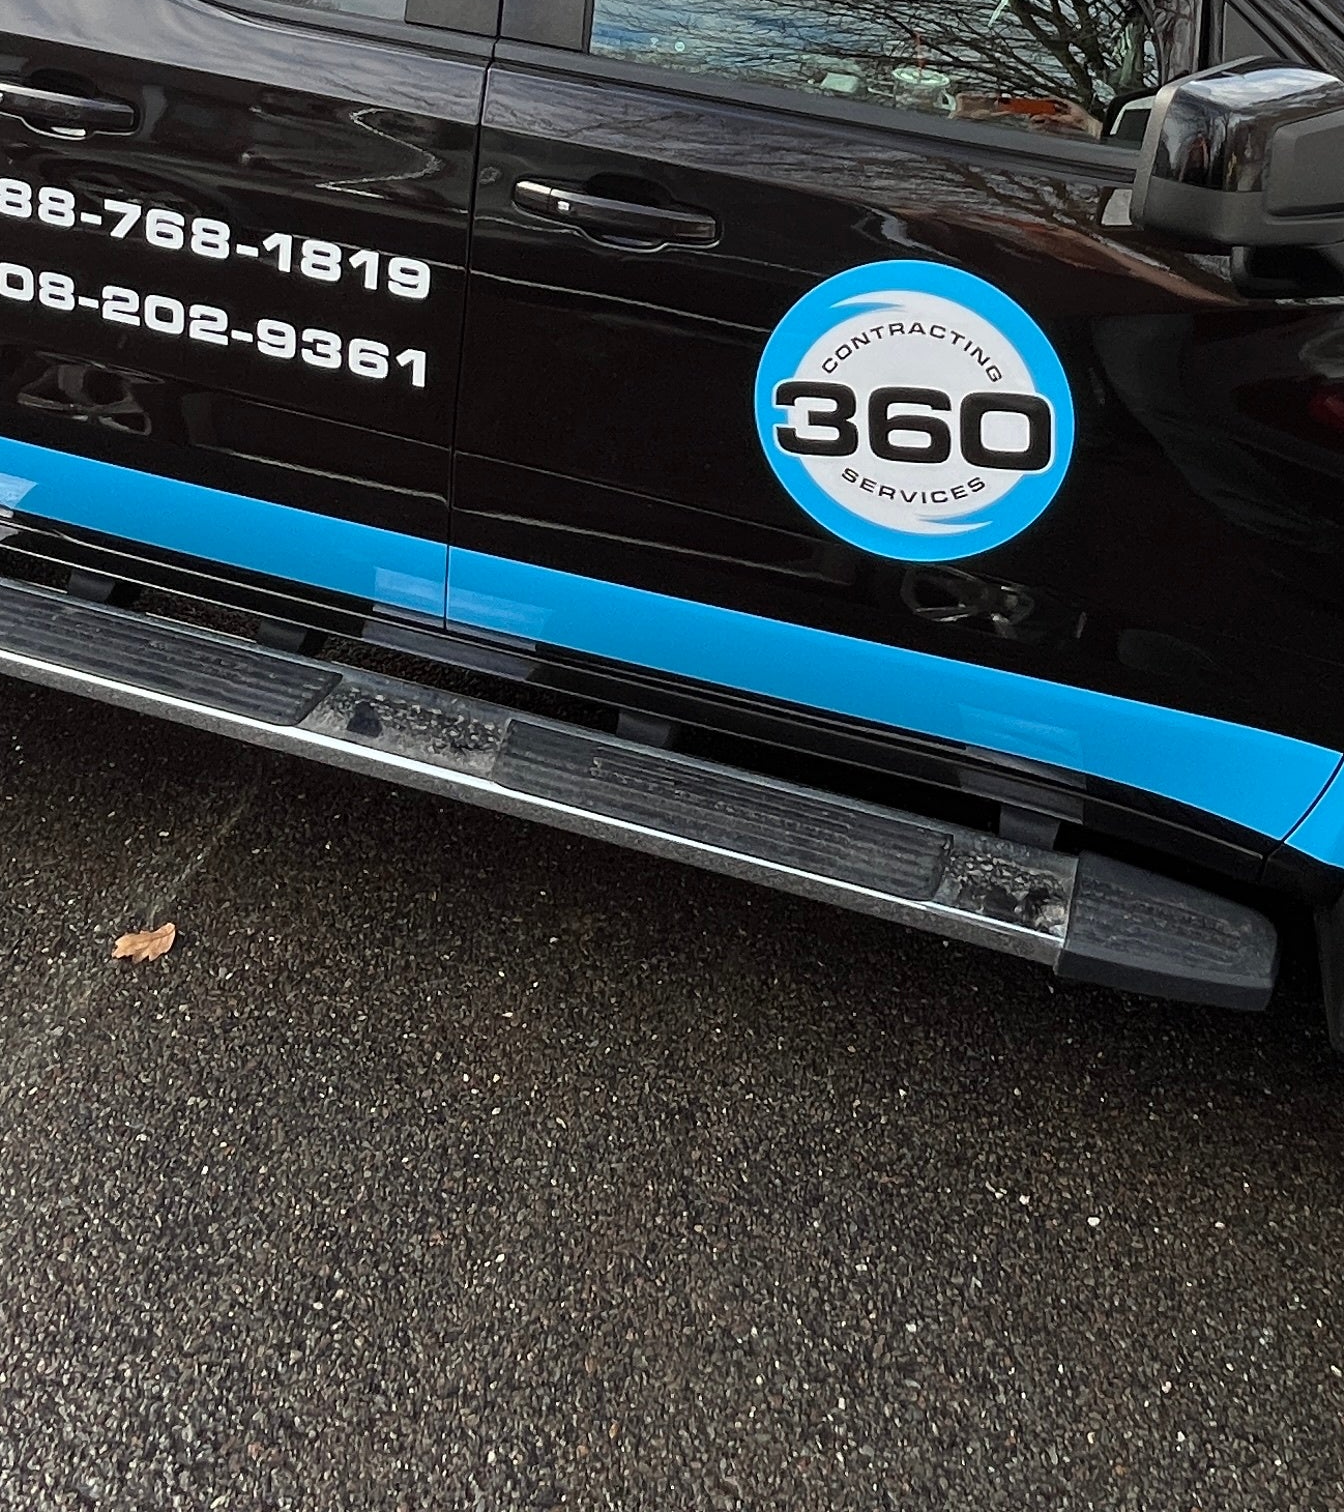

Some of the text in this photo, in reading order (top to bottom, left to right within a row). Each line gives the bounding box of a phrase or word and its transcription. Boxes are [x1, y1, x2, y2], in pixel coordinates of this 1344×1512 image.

[821, 322, 1003, 383] CONTRACTING
[773, 380, 1054, 472] 360
[841, 467, 986, 504] SERVICES
